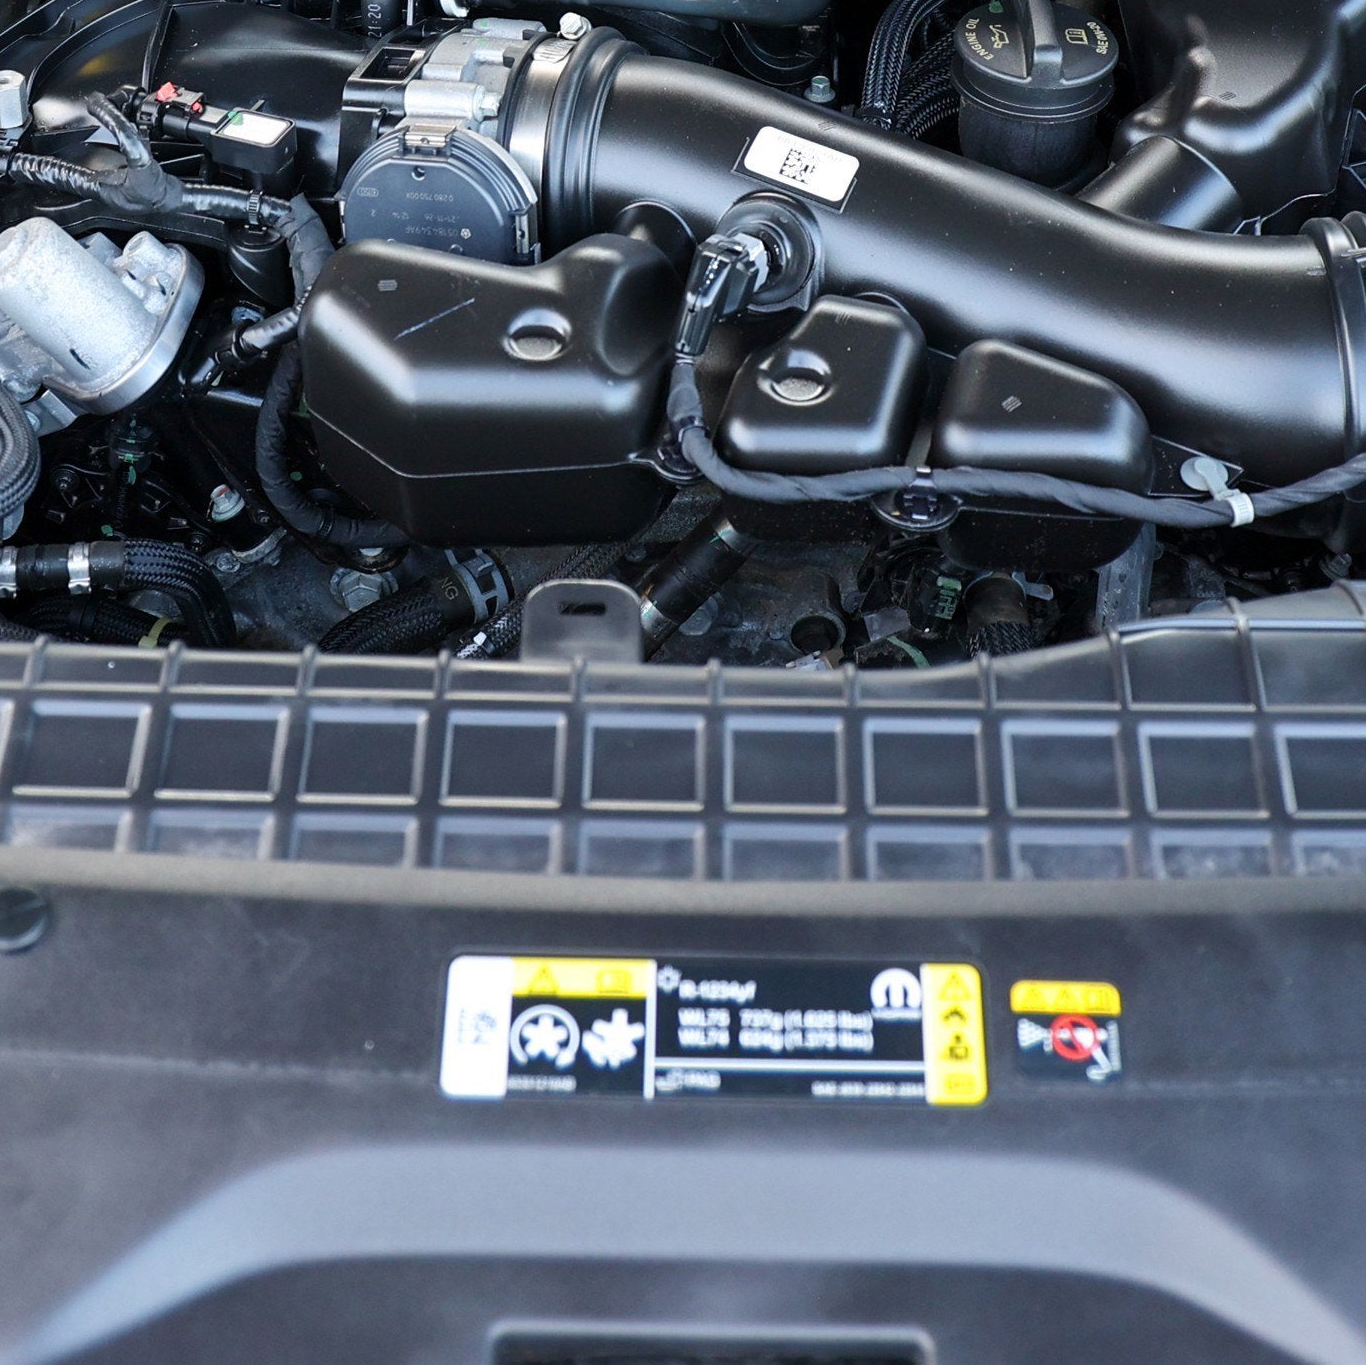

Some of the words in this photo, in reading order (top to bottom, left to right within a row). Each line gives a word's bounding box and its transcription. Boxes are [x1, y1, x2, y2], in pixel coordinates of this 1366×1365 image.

[966, 18, 981, 30] OIL
[965, 31, 995, 61] ENGINE
[1096, 40, 1109, 55] SAE
